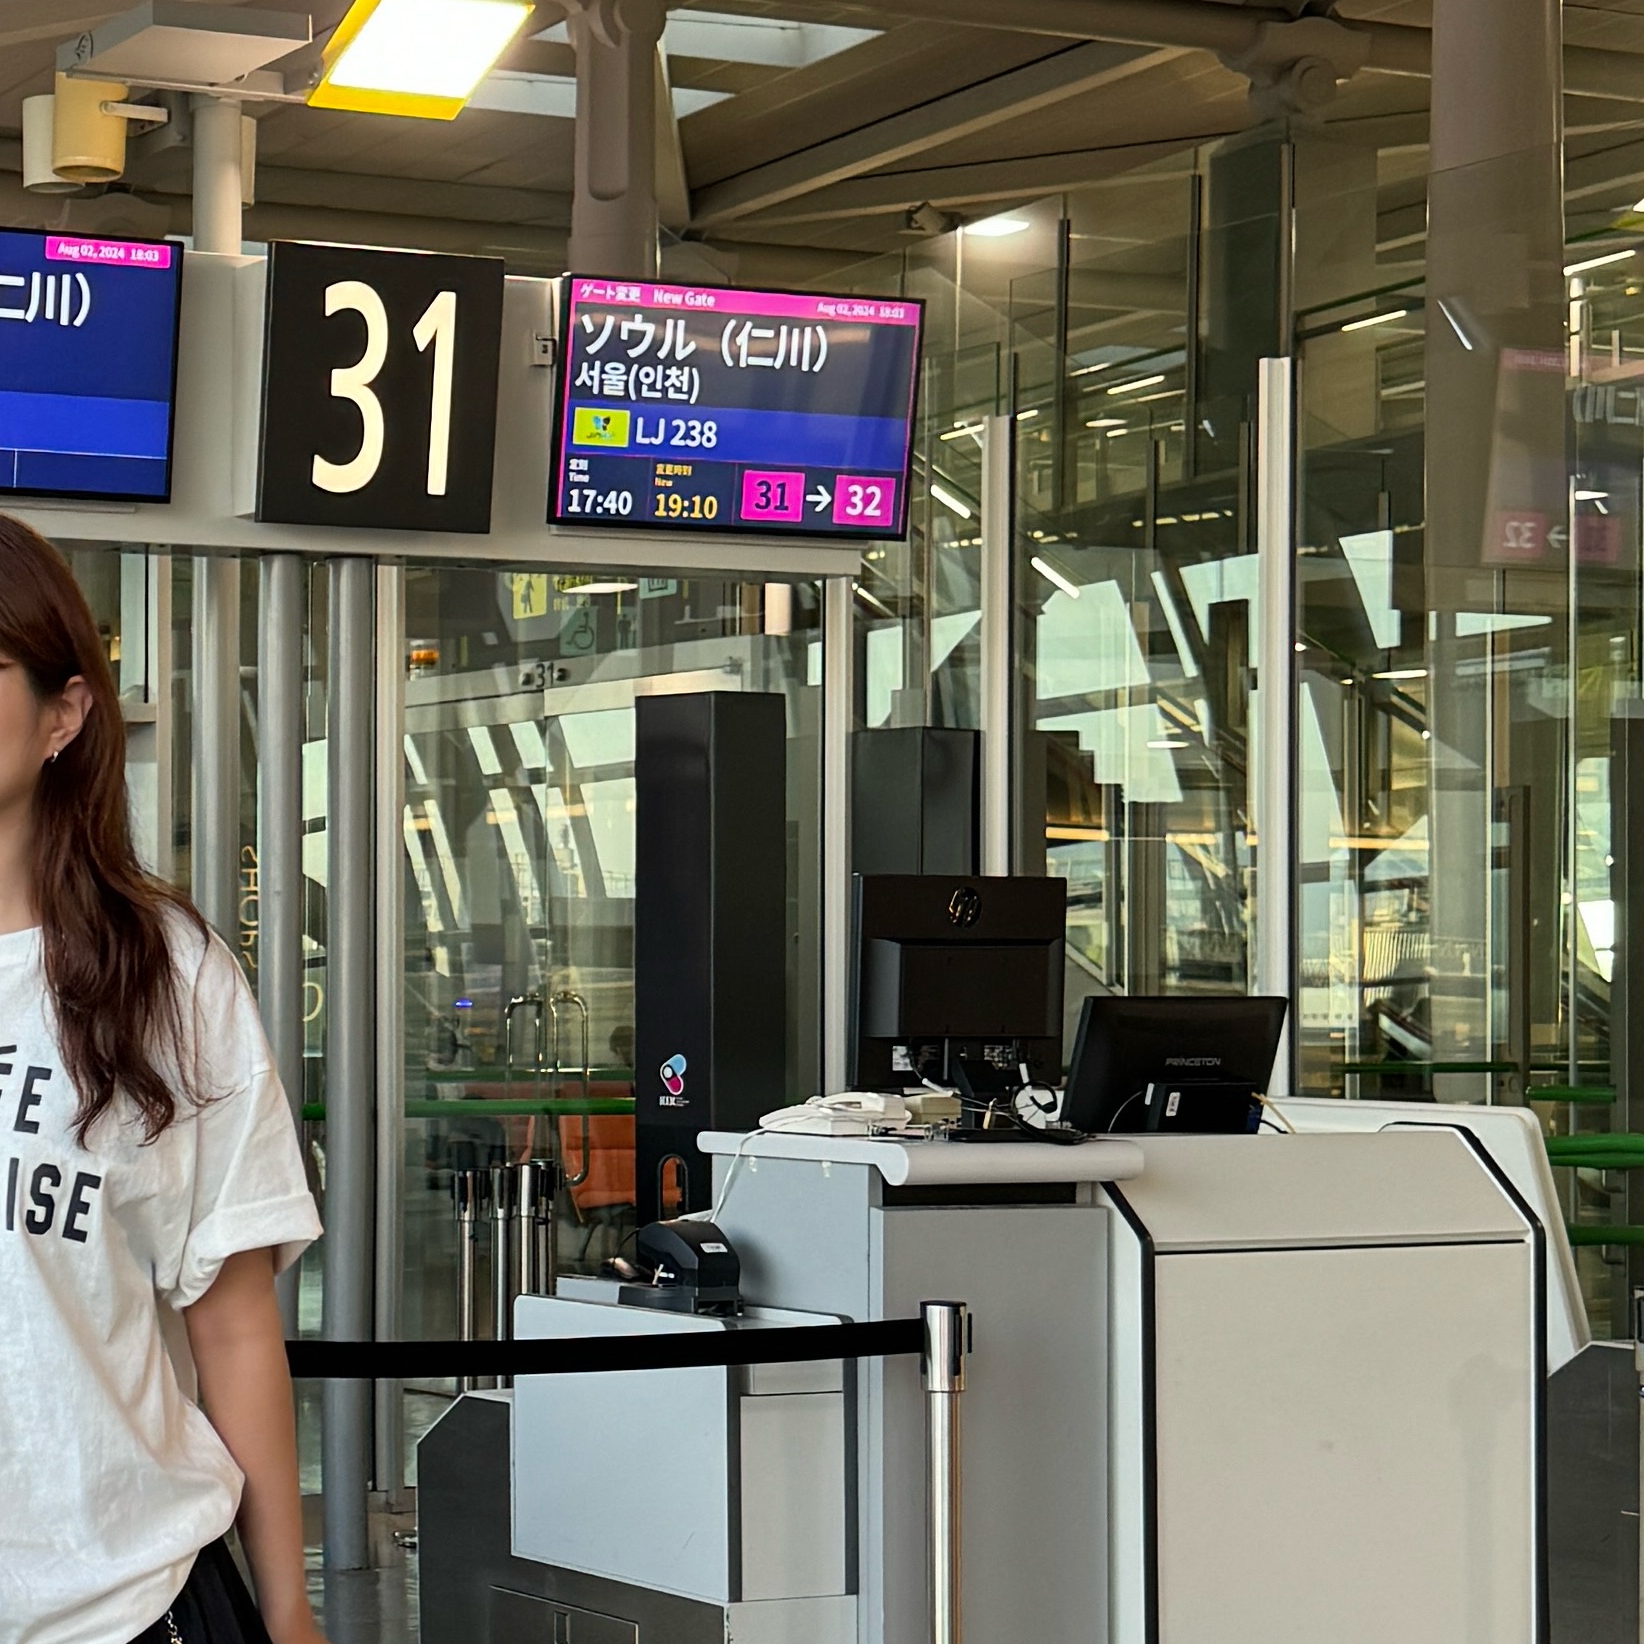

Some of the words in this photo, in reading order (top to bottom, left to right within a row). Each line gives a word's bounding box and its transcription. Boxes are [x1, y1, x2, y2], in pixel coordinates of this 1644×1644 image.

[57, 241, 80, 259] Aug
[80, 244, 97, 258] 02,
[99, 245, 125, 260] 2024
[653, 288, 683, 305] New
[684, 291, 716, 308] Gate
[311, 279, 457, 497] 31
[574, 360, 700, 405] 서울(인천)
[635, 416, 666, 446] LJ
[669, 418, 718, 449] 238
[567, 488, 634, 516] 17:40
[654, 492, 719, 520] 19:10
[754, 480, 790, 513] 31
[844, 485, 882, 518] 32
